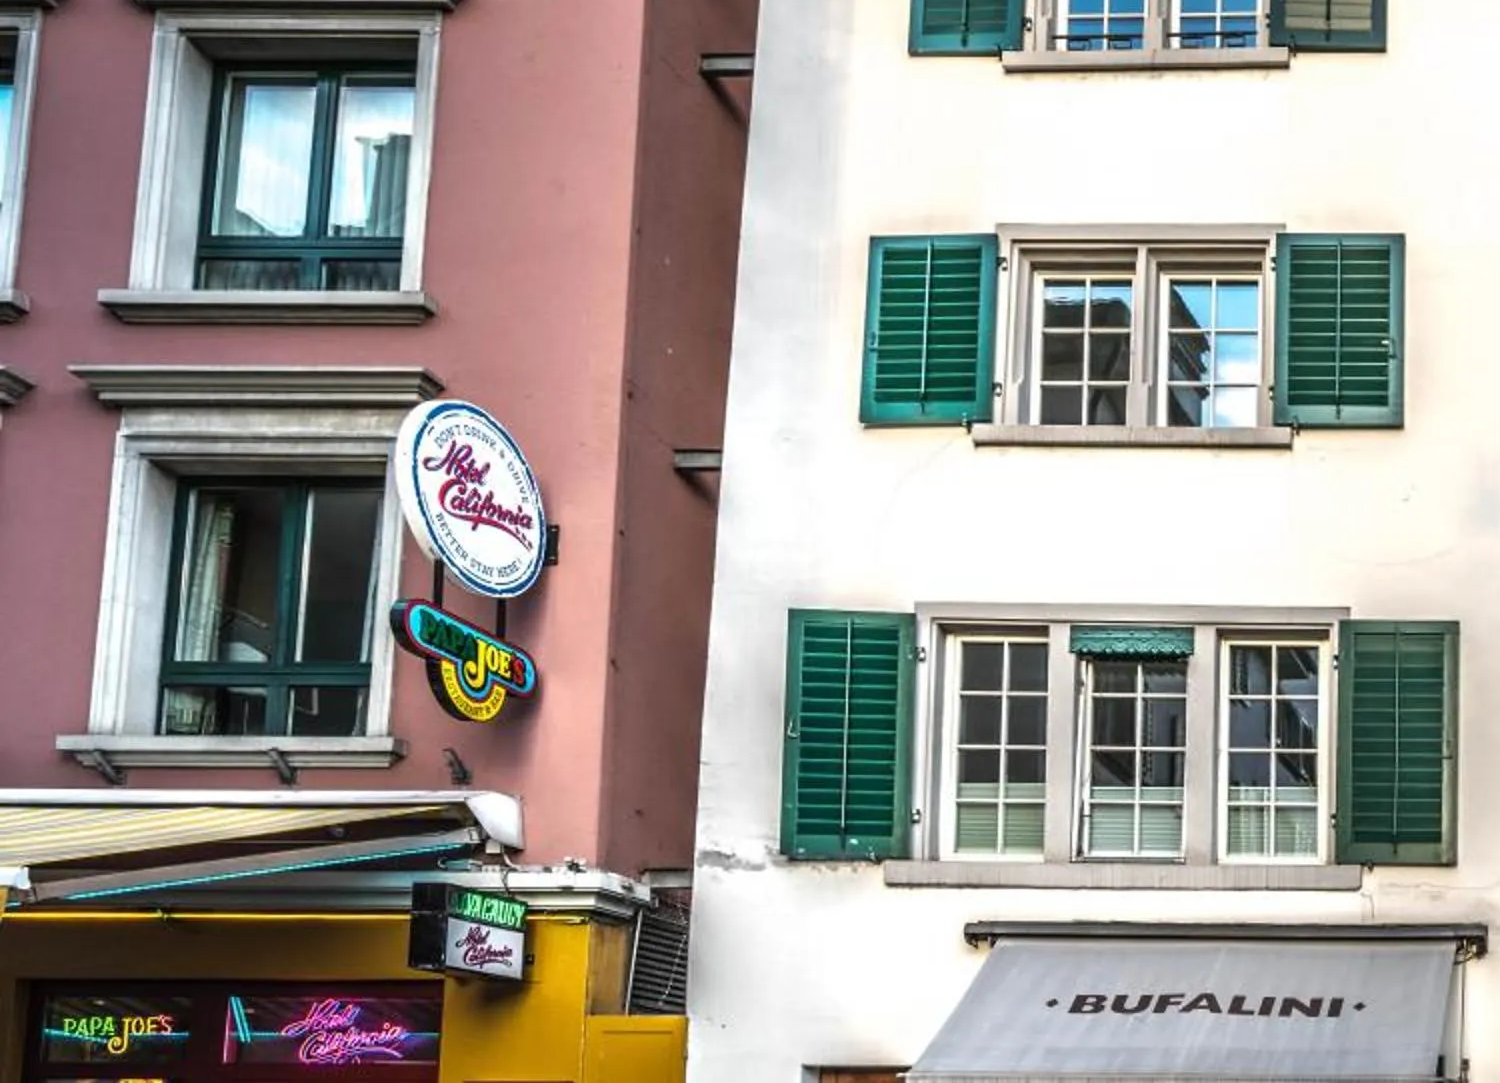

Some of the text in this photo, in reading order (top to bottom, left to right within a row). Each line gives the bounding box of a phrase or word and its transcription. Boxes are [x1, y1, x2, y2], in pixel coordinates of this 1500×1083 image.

[422, 439, 491, 487] Hotel
[438, 478, 534, 551] California
[435, 512, 469, 562] BETTER
[419, 608, 526, 688] PAPA JOE'S
[463, 944, 513, 969] California
[1068, 993, 1345, 1018] BUFALINI
[63, 1014, 175, 1054] PAPA JOE'S
[299, 1027, 407, 1064] California
